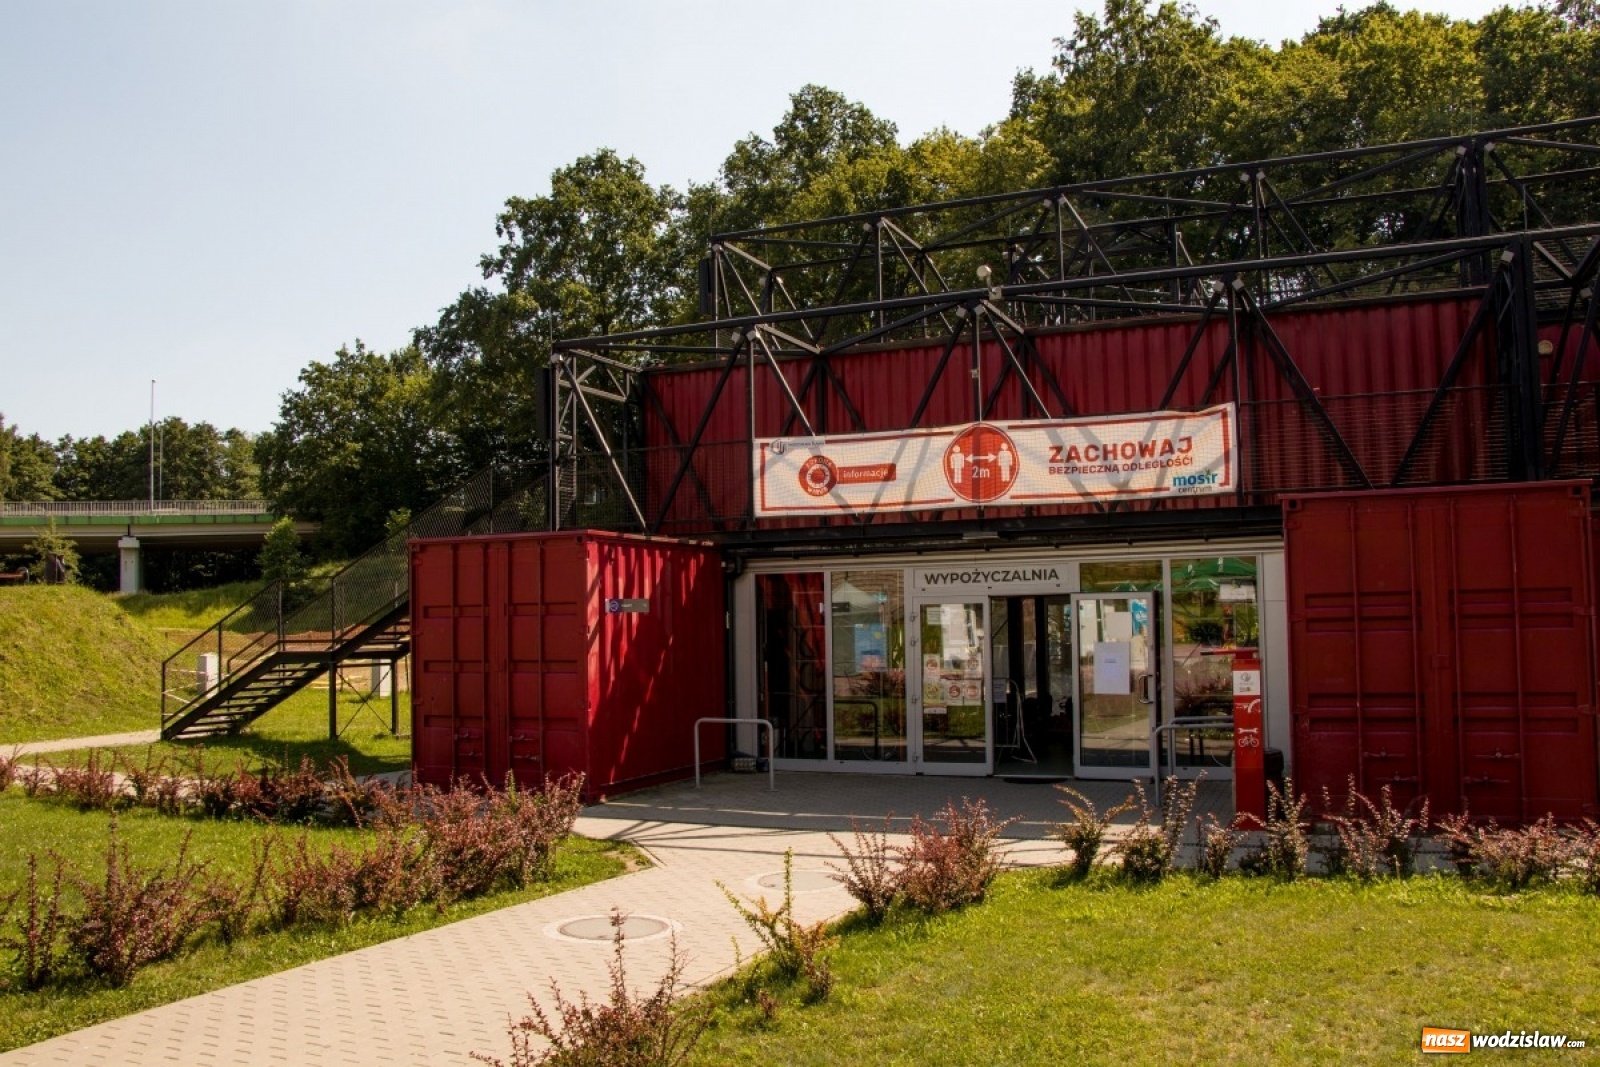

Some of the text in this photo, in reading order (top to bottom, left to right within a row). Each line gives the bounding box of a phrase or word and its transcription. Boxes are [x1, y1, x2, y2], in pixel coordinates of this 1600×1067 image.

[1049, 436, 1193, 464] ZACHOWAJ
[843, 469, 889, 479] informacje
[971, 465, 990, 479] 2m
[1049, 464, 1120, 475] BEZPIECZNĄ
[1172, 469, 1218, 487] mosir
[924, 568, 1060, 585] WYPOŻYCZALNIA
